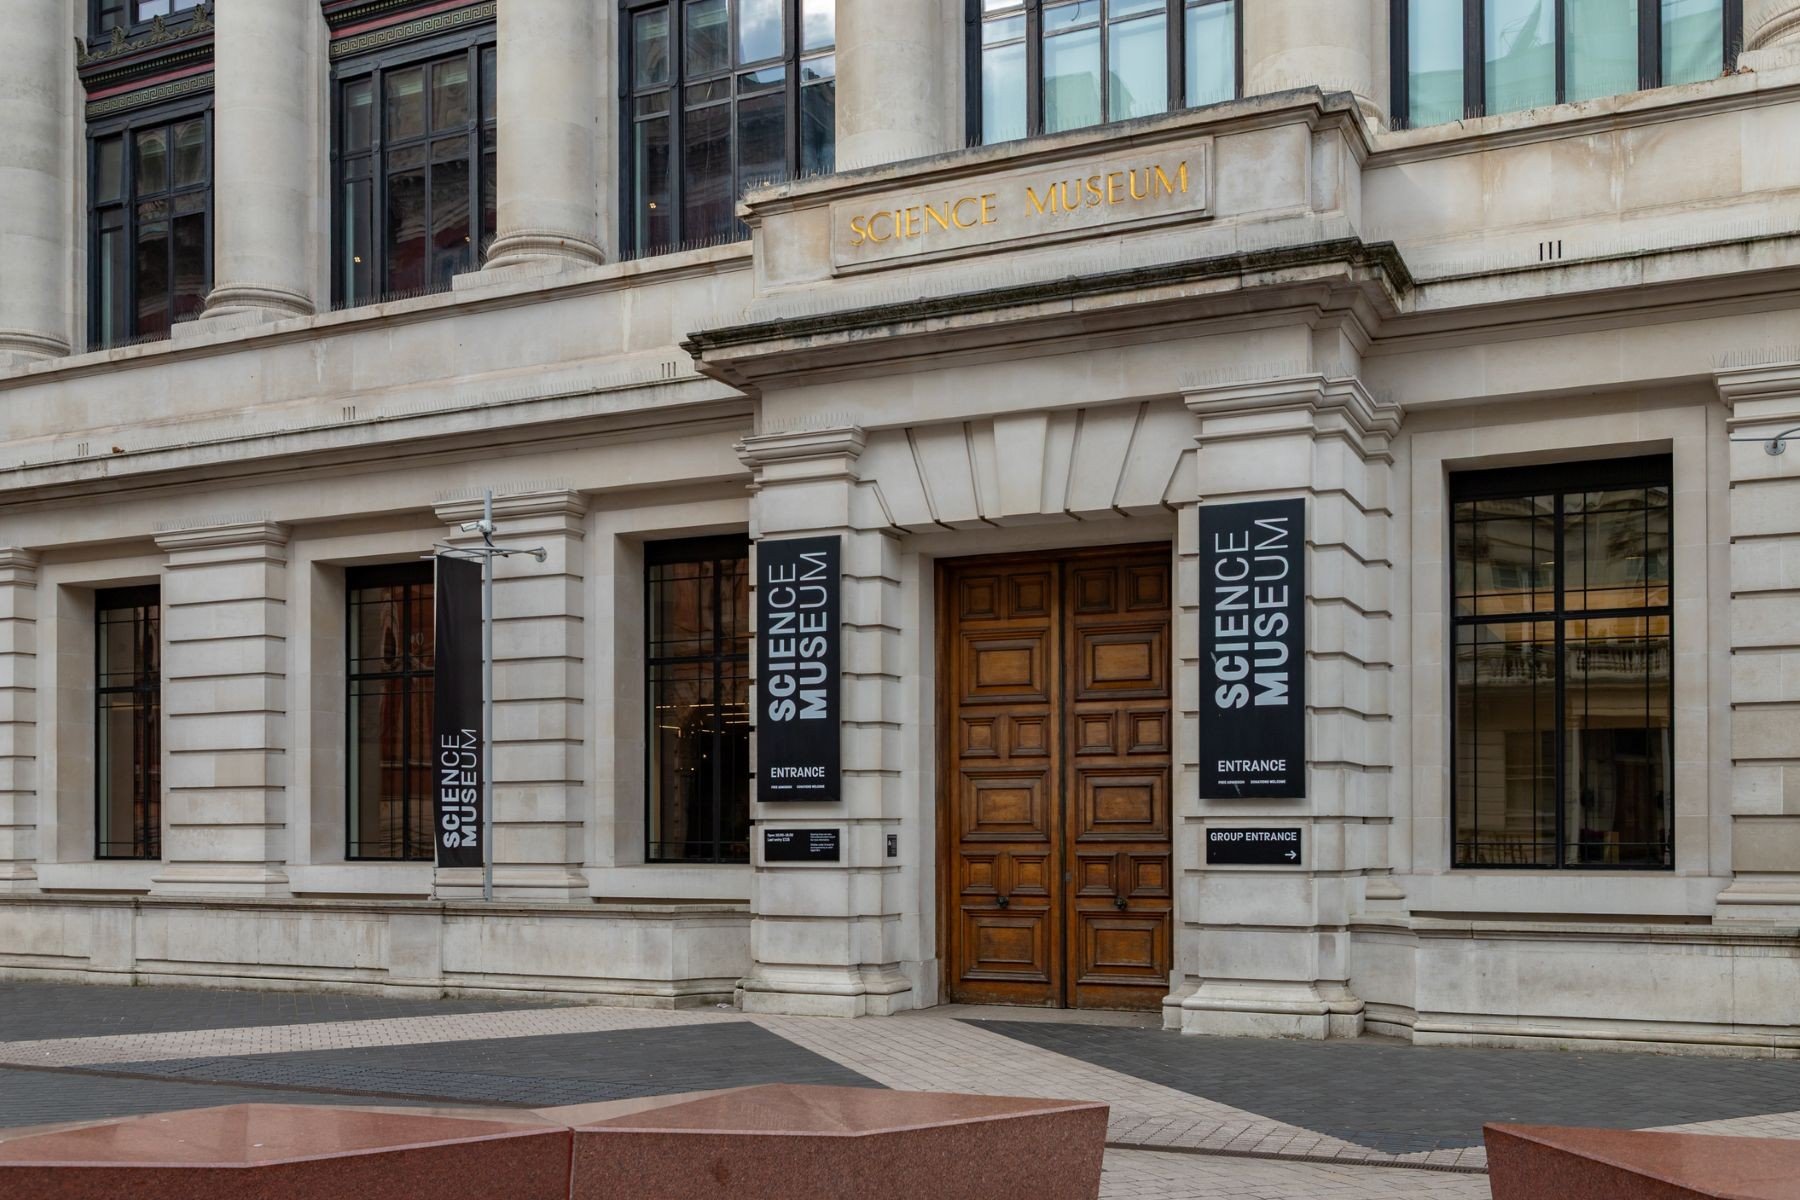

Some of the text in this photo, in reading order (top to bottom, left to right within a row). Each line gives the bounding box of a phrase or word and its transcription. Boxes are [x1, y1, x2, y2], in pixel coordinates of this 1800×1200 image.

[850, 161, 1188, 247] SCIENCE MUSEUM
[768, 563, 796, 721] SCIENCE
[799, 551, 827, 719] MUSEUM
[1215, 530, 1249, 709] SCIENCE
[1254, 517, 1289, 706] MUSEUM
[441, 735, 461, 848] SCIENCE
[461, 729, 477, 847] MUSEUM
[770, 766, 825, 778] ENTRANCE
[1218, 759, 1286, 772] ENTRANCE
[1210, 831, 1297, 841] GROUP ENTRANCE
